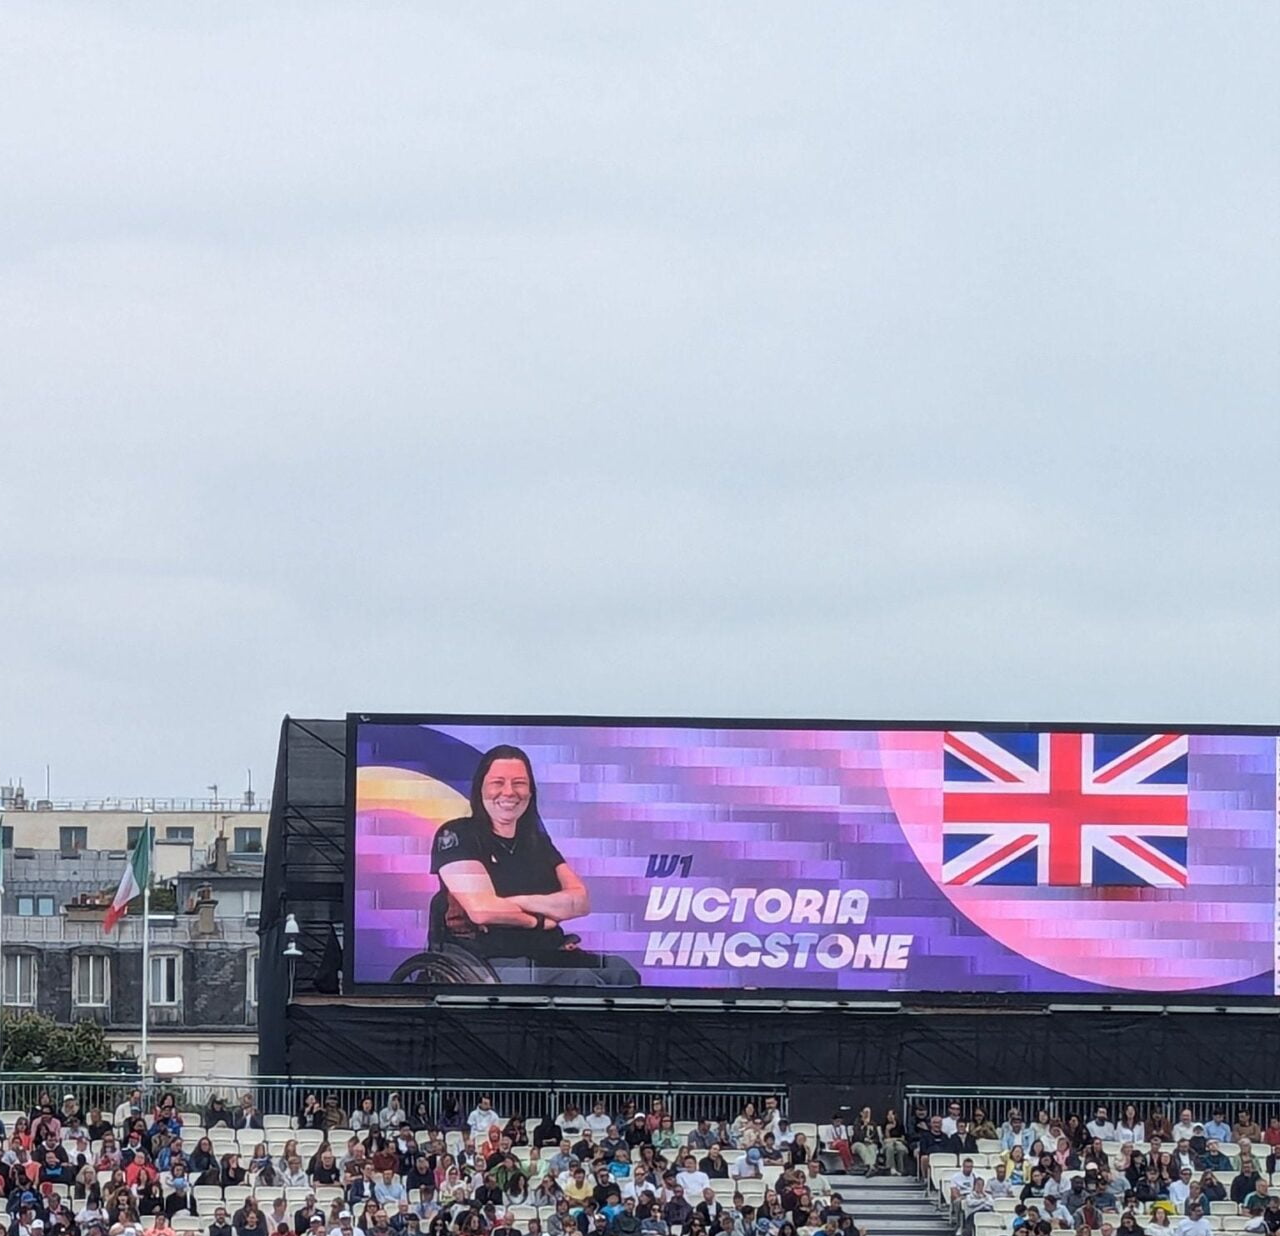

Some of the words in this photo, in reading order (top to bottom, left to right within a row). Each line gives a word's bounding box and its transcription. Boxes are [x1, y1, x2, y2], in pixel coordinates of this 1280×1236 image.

[645, 854, 693, 879] W1
[644, 886, 870, 924] VICTORIA
[643, 931, 914, 969] KINGSTONE
